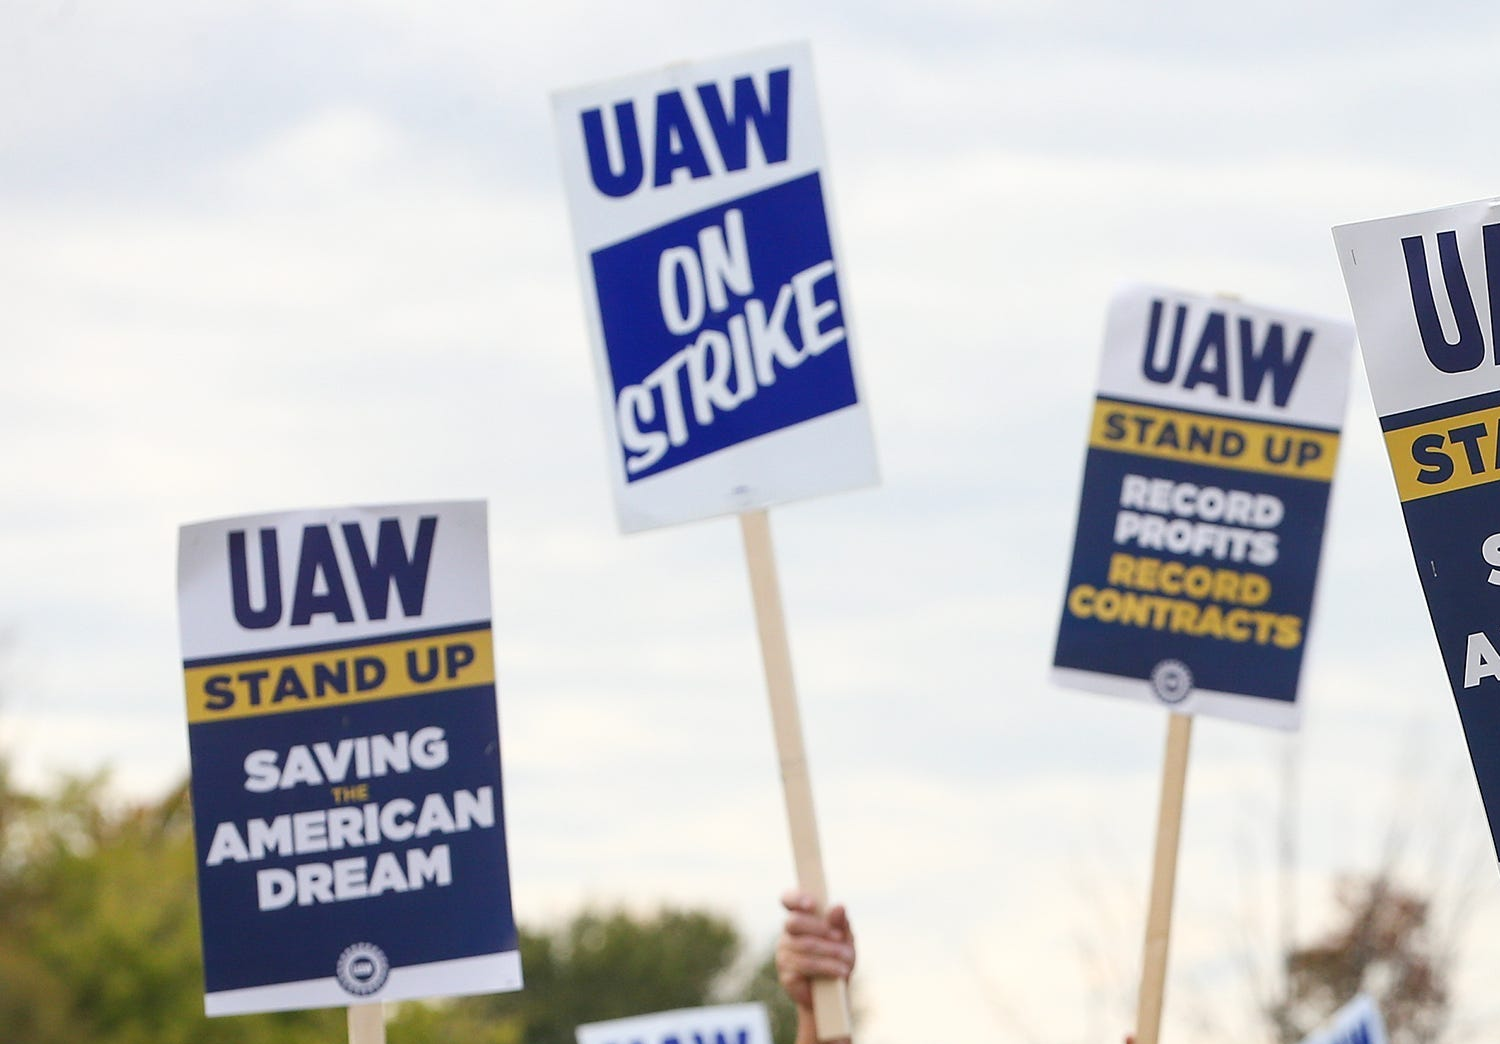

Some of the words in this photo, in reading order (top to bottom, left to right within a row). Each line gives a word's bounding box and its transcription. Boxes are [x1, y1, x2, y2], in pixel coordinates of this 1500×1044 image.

[580, 67, 792, 198] UAW
[657, 207, 755, 336] ON
[617, 259, 847, 475] STRIKE
[1141, 298, 1315, 409] UAW
[1104, 412, 1248, 460] STAND
[1264, 437, 1323, 468] UP
[1119, 473, 1286, 530] RECORD
[1112, 510, 1280, 567] PROFITS
[227, 515, 438, 631] UAW
[1107, 553, 1272, 606] RECORD
[1068, 583, 1303, 650] CONTRACTS
[203, 656, 387, 712] STAND
[405, 642, 476, 684] UP
[243, 726, 449, 793] SAVING
[330, 783, 370, 804] THE
[206, 786, 495, 866] AMERICAN
[256, 844, 452, 912] DREAM
